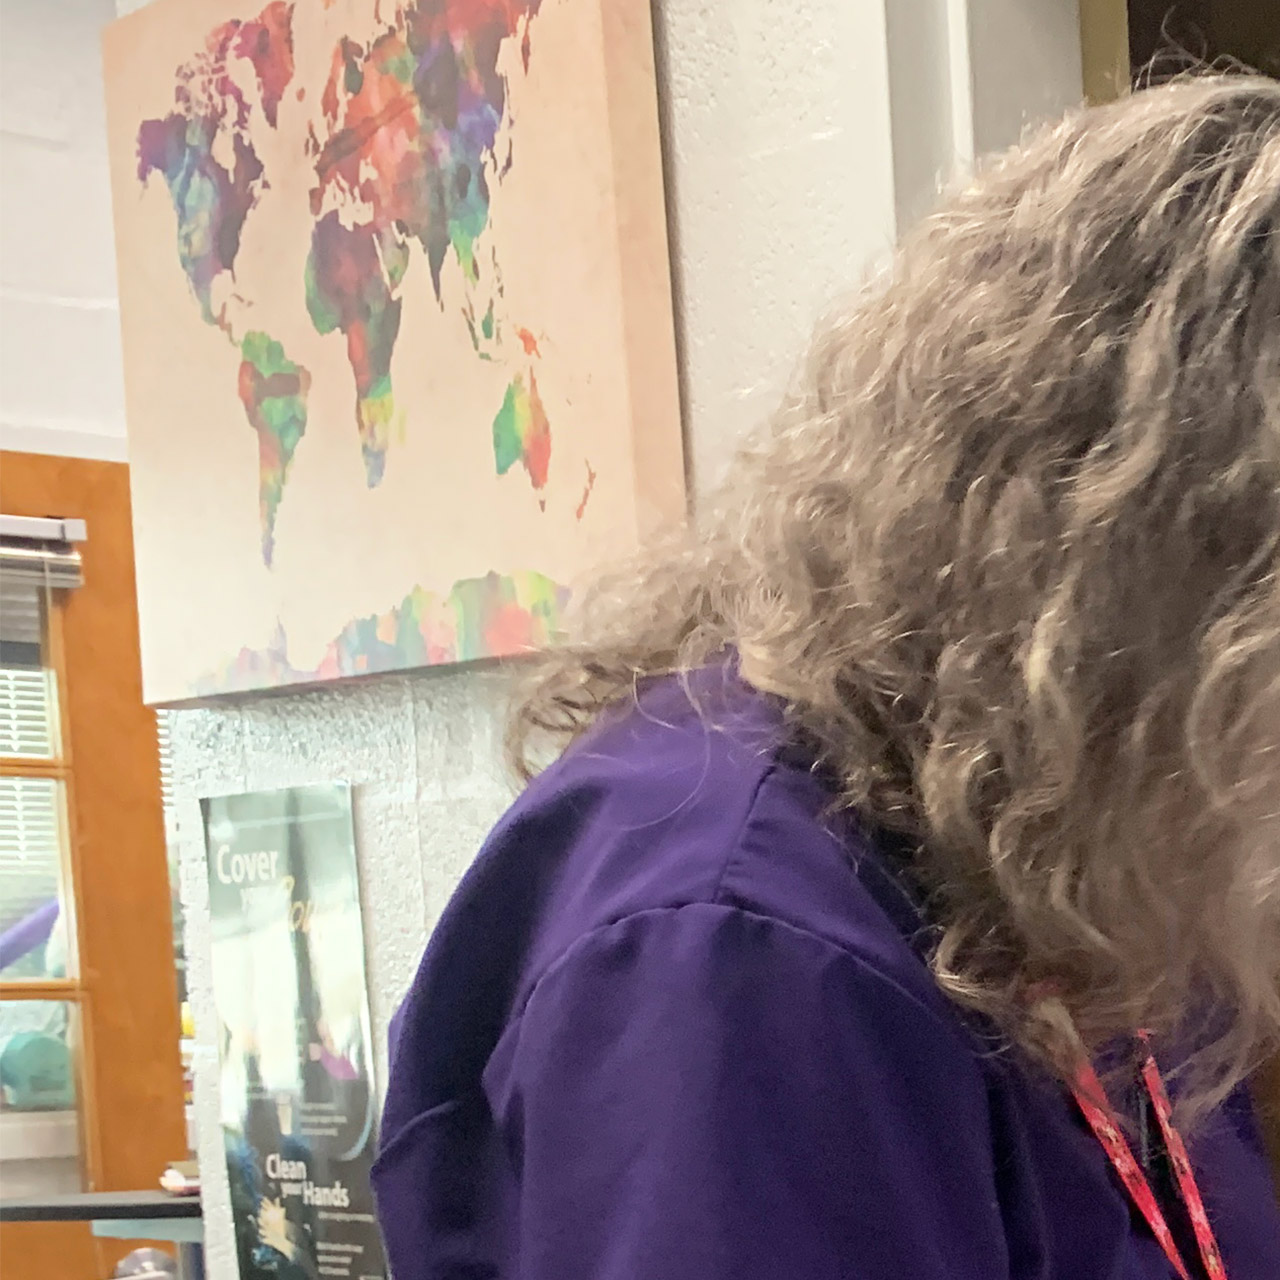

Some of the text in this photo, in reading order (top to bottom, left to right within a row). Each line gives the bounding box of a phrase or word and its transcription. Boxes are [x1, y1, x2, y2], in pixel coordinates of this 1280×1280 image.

[217, 844, 278, 884] Cover
[266, 1153, 307, 1180] Clean
[303, 1179, 350, 1208] Hands
